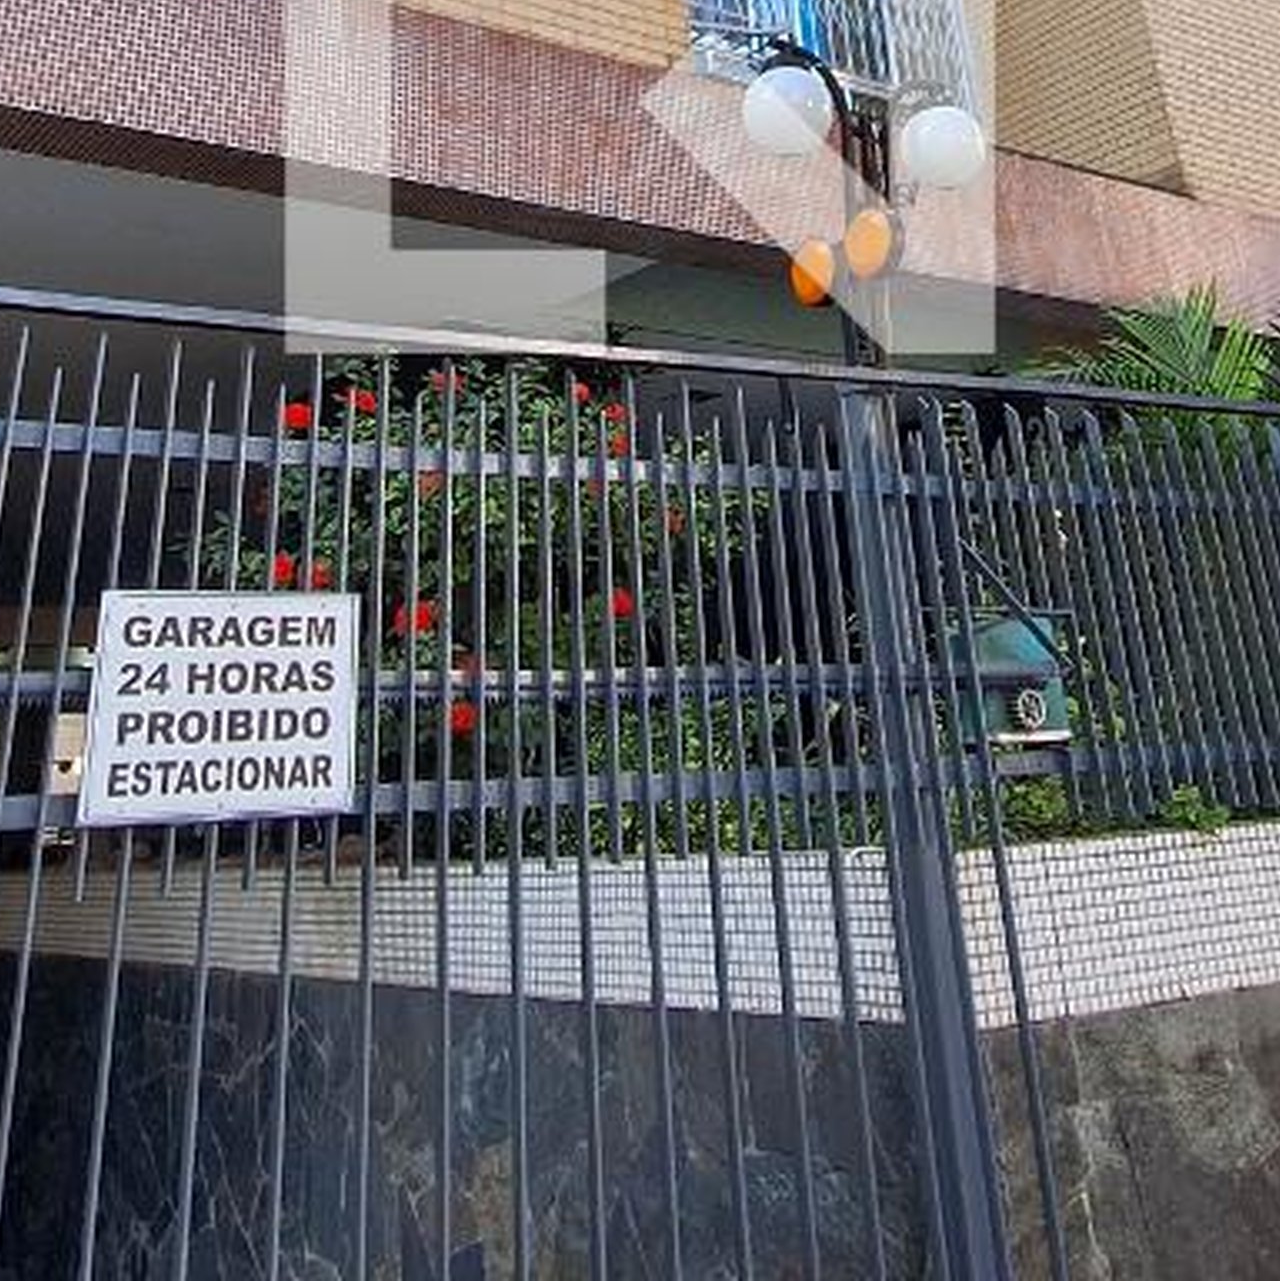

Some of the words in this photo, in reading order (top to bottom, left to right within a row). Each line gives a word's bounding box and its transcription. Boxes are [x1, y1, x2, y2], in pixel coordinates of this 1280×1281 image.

[123, 616, 336, 648] GARAGEM
[117, 663, 169, 695] 24
[187, 661, 335, 694] HORAS
[117, 708, 330, 745] PROIBIDO
[107, 755, 333, 798] ESTACIONAR
